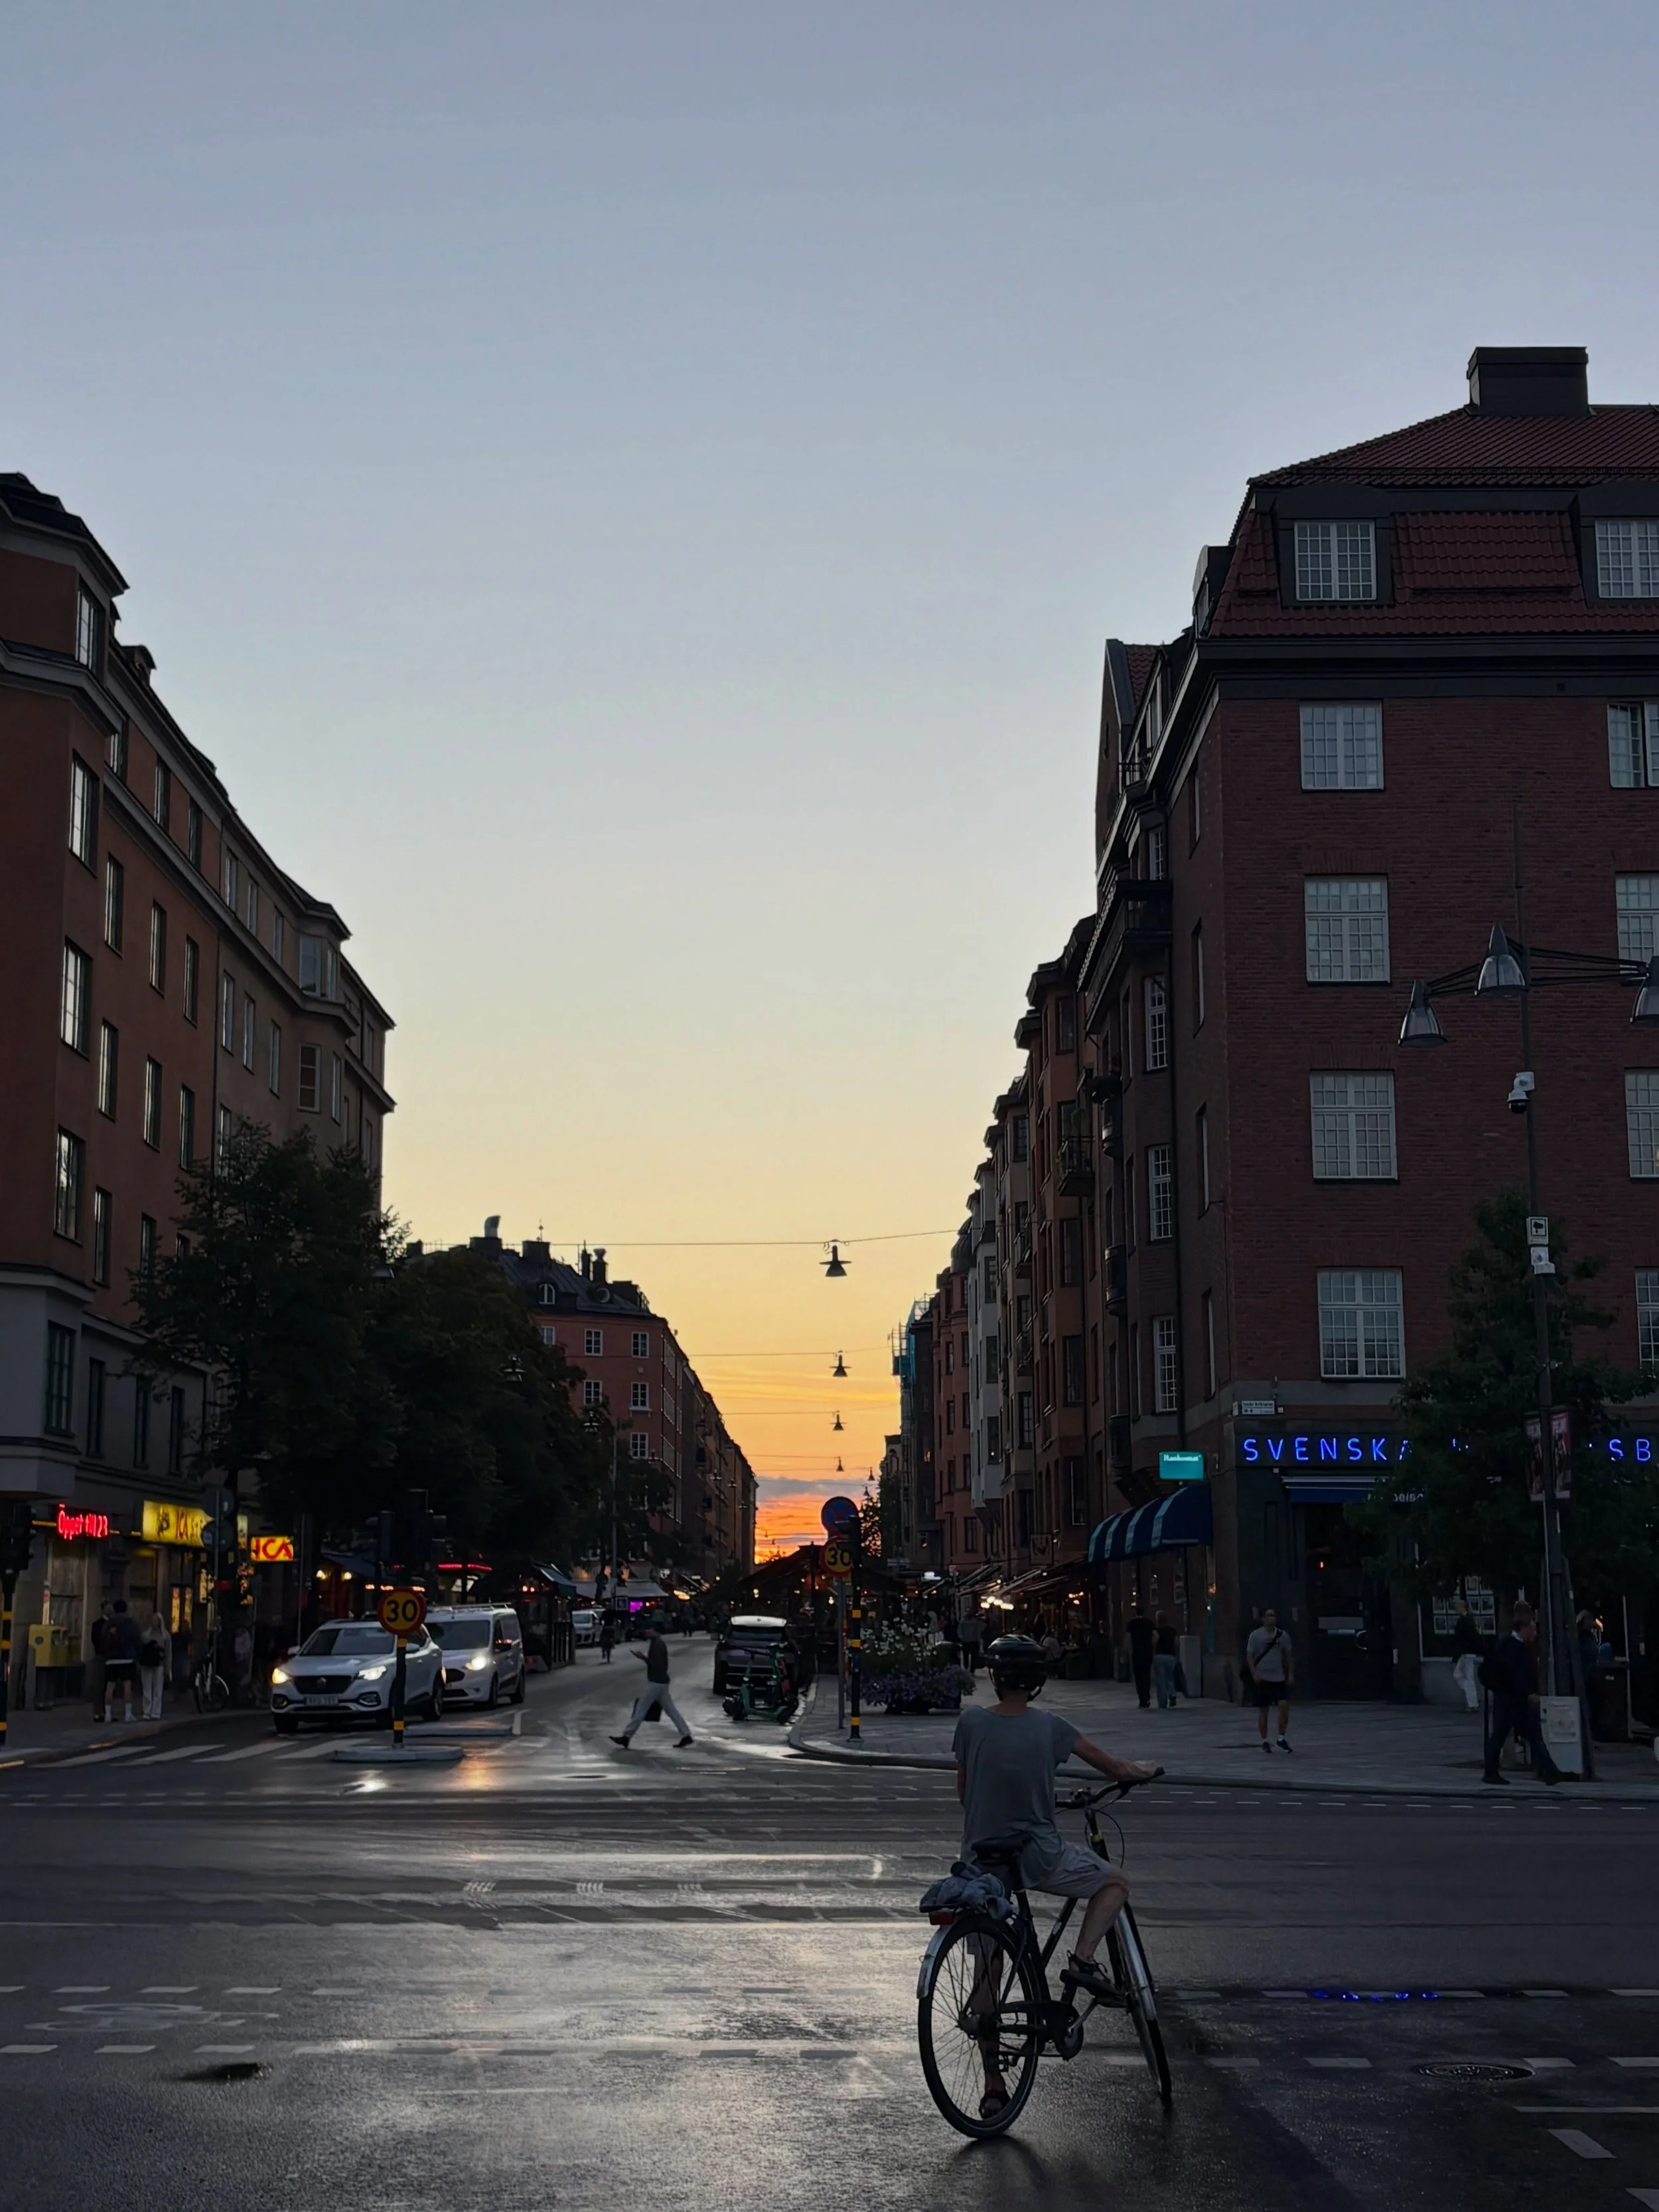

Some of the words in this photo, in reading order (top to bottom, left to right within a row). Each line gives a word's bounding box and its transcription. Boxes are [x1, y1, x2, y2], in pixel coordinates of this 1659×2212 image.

[255, 1538, 293, 1560] ICA
[827, 1546, 852, 1567] 30
[386, 1599, 418, 1622] 30
